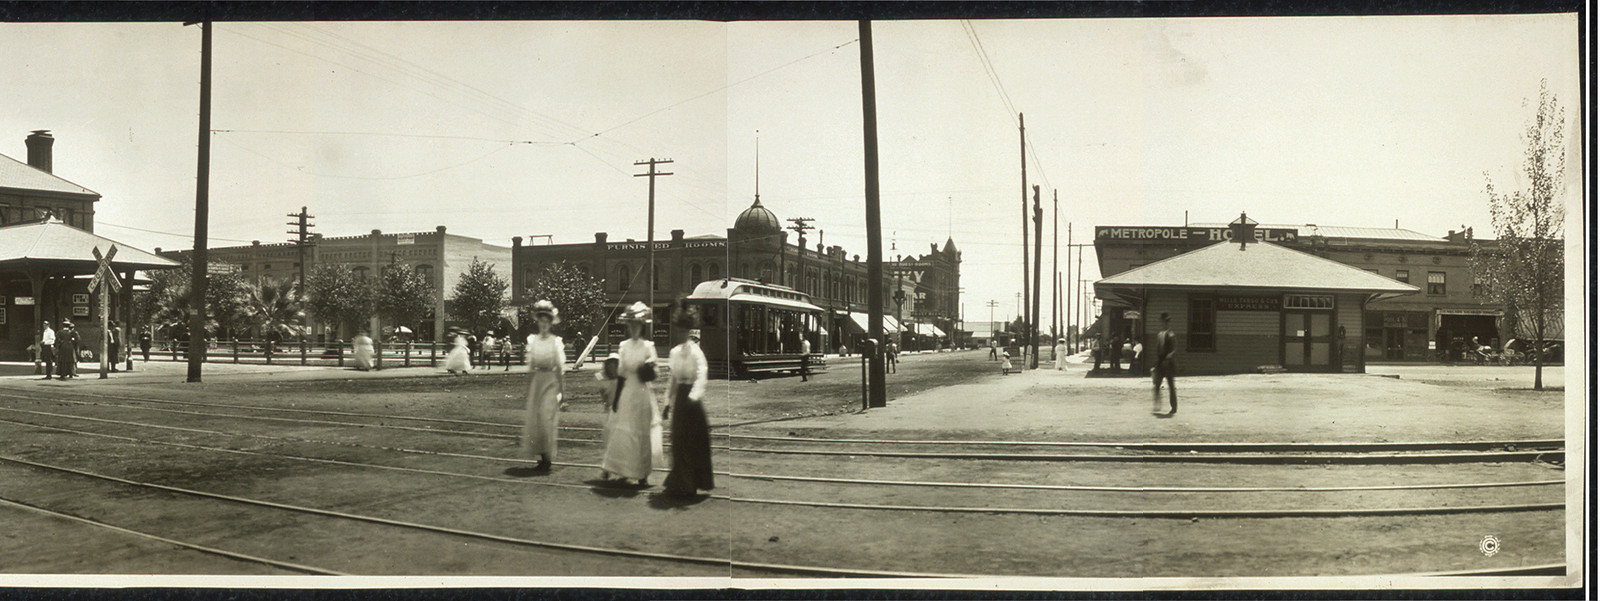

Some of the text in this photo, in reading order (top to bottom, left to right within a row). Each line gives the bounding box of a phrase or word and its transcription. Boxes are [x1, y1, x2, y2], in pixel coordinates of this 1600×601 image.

[1110, 228, 1188, 239] METROPOLE
[1208, 229, 1284, 241] HOEL.
[607, 242, 670, 250] FURNISED
